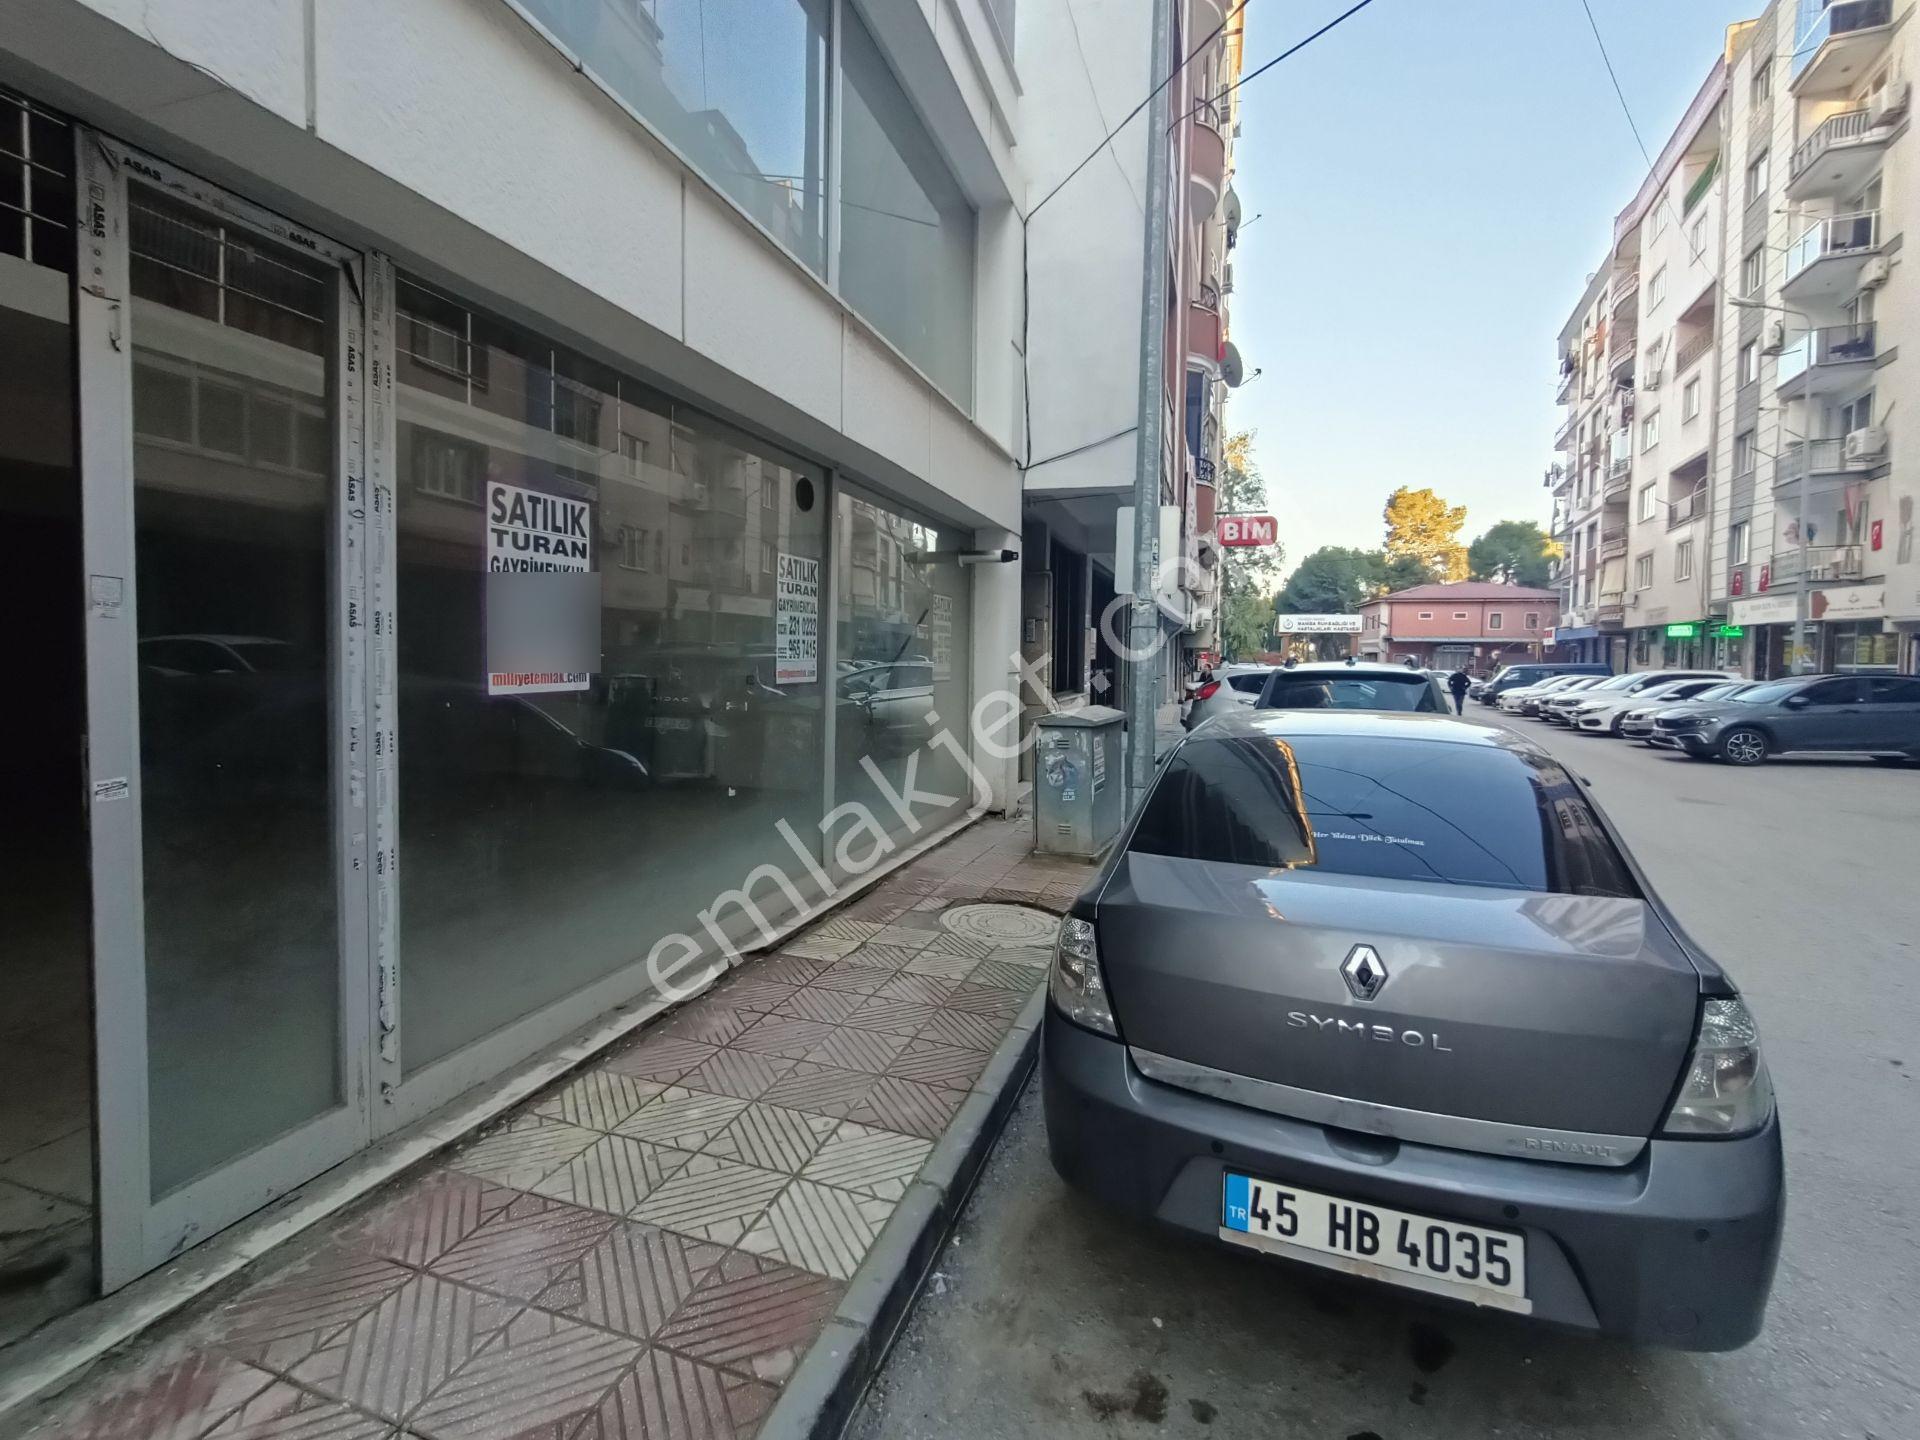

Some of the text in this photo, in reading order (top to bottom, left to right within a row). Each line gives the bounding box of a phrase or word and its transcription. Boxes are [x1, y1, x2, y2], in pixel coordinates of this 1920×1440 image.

[491, 487, 587, 538] SATILIK
[490, 527, 587, 559] TURAN
[779, 556, 817, 584] SATILIK
[778, 581, 817, 598] TURAN
[1286, 1011, 1452, 1052] SYMBOL
[1524, 1137, 1617, 1158] RENAULT
[1229, 1205, 1246, 1221] TR
[1250, 1186, 1512, 1287] 45 HB 4035
